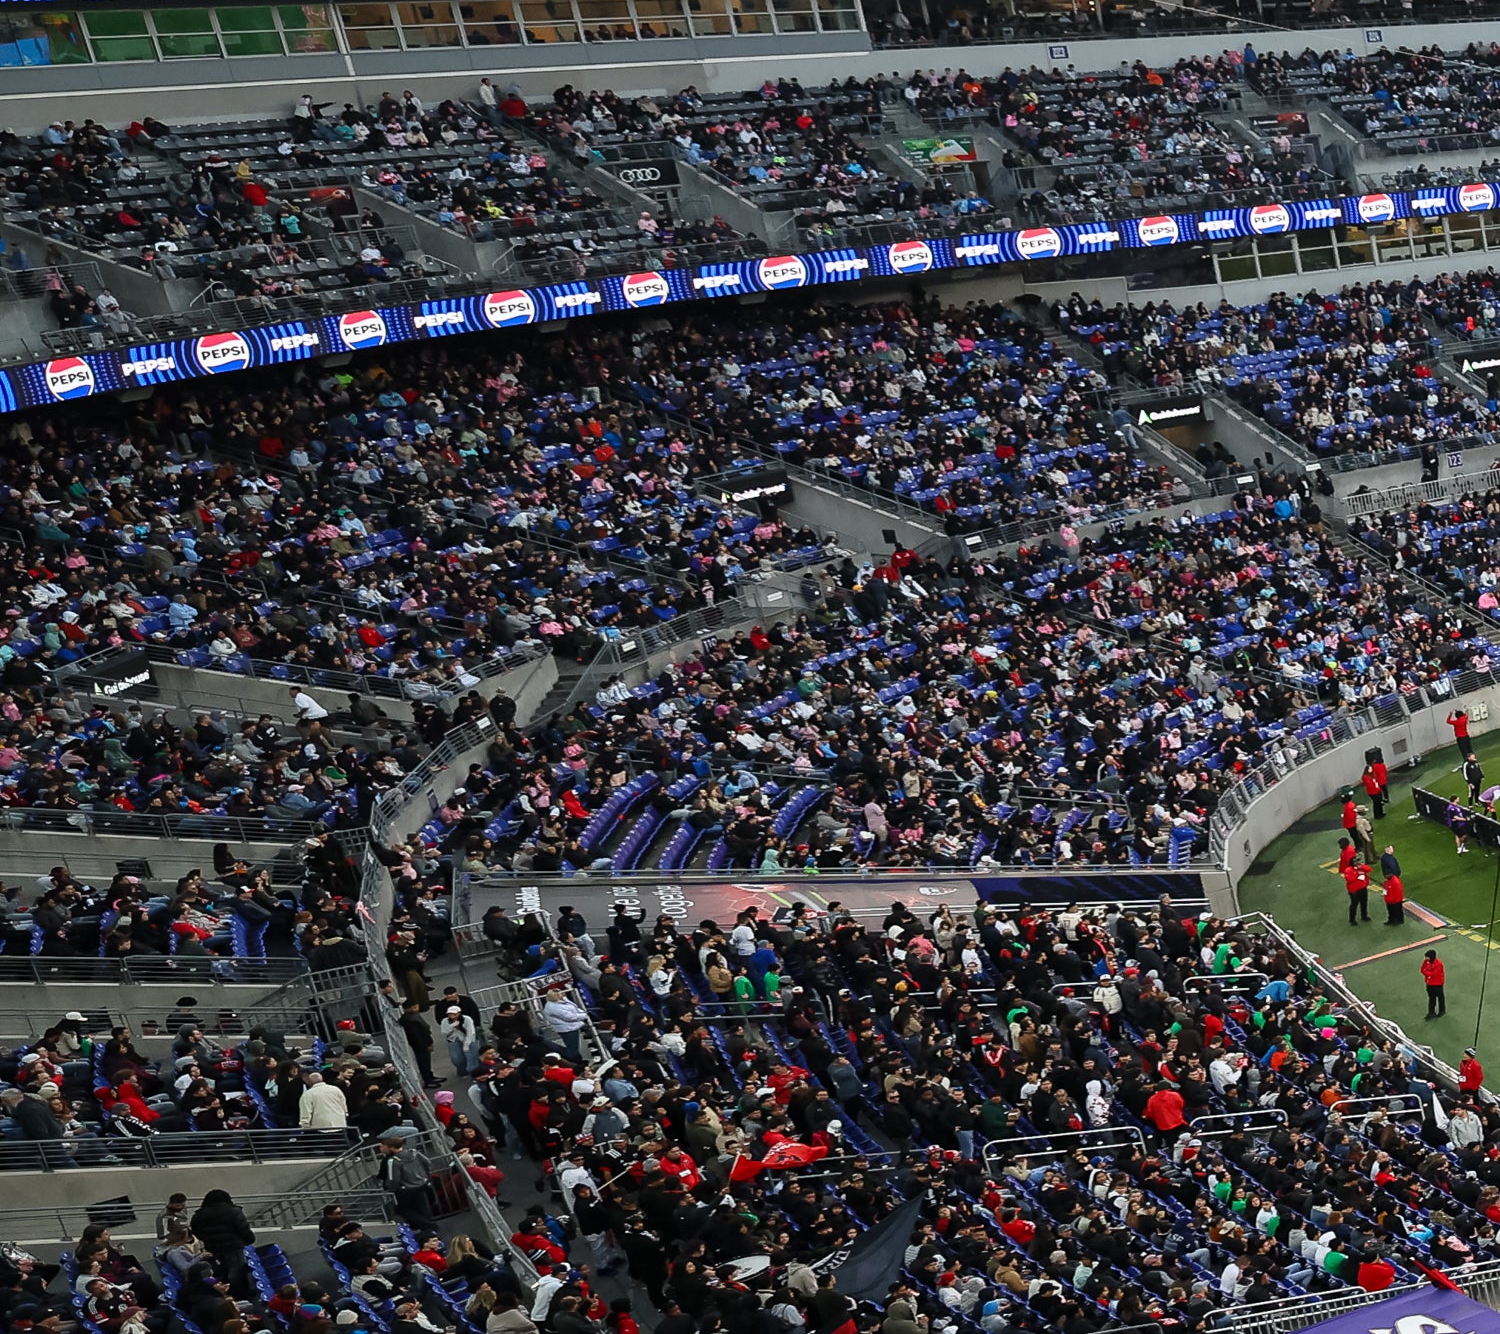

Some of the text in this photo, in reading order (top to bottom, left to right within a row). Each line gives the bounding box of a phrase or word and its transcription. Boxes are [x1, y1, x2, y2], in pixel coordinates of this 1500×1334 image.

[764, 267, 802, 280] PEPSI
[628, 283, 664, 296] PEPSI
[489, 302, 531, 315] PEPSI
[414, 310, 465, 329] PEPSI
[344, 322, 382, 336] PEPSI
[271, 333, 319, 353] PEPSI
[201, 345, 246, 361] PEPSI
[122, 357, 176, 376] PEPSI
[50, 371, 91, 388] PEPSI
